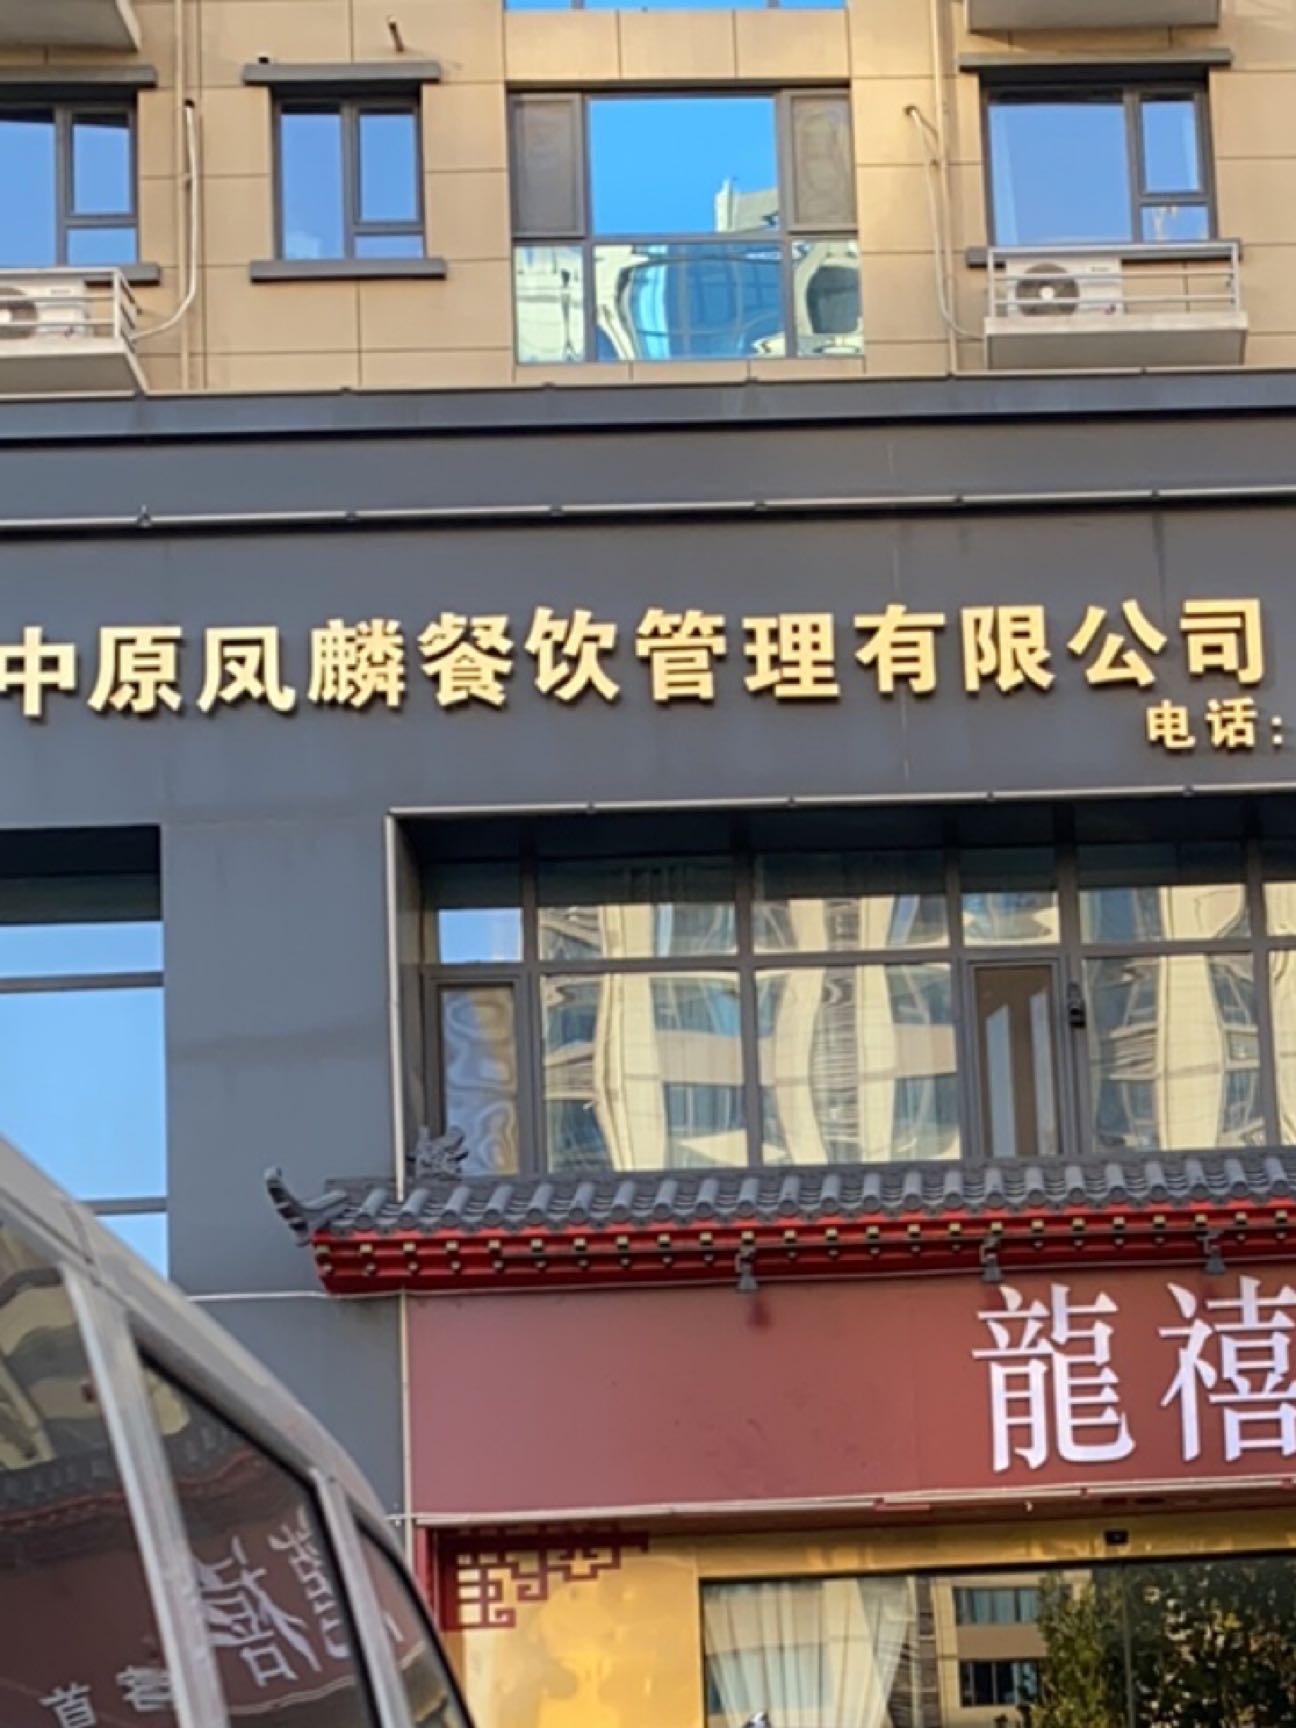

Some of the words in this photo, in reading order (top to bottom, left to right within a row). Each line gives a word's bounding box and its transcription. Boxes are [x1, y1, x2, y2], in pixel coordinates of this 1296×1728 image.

[0, 596, 1265, 718] 中原凤麟餐饮管理有限公司
